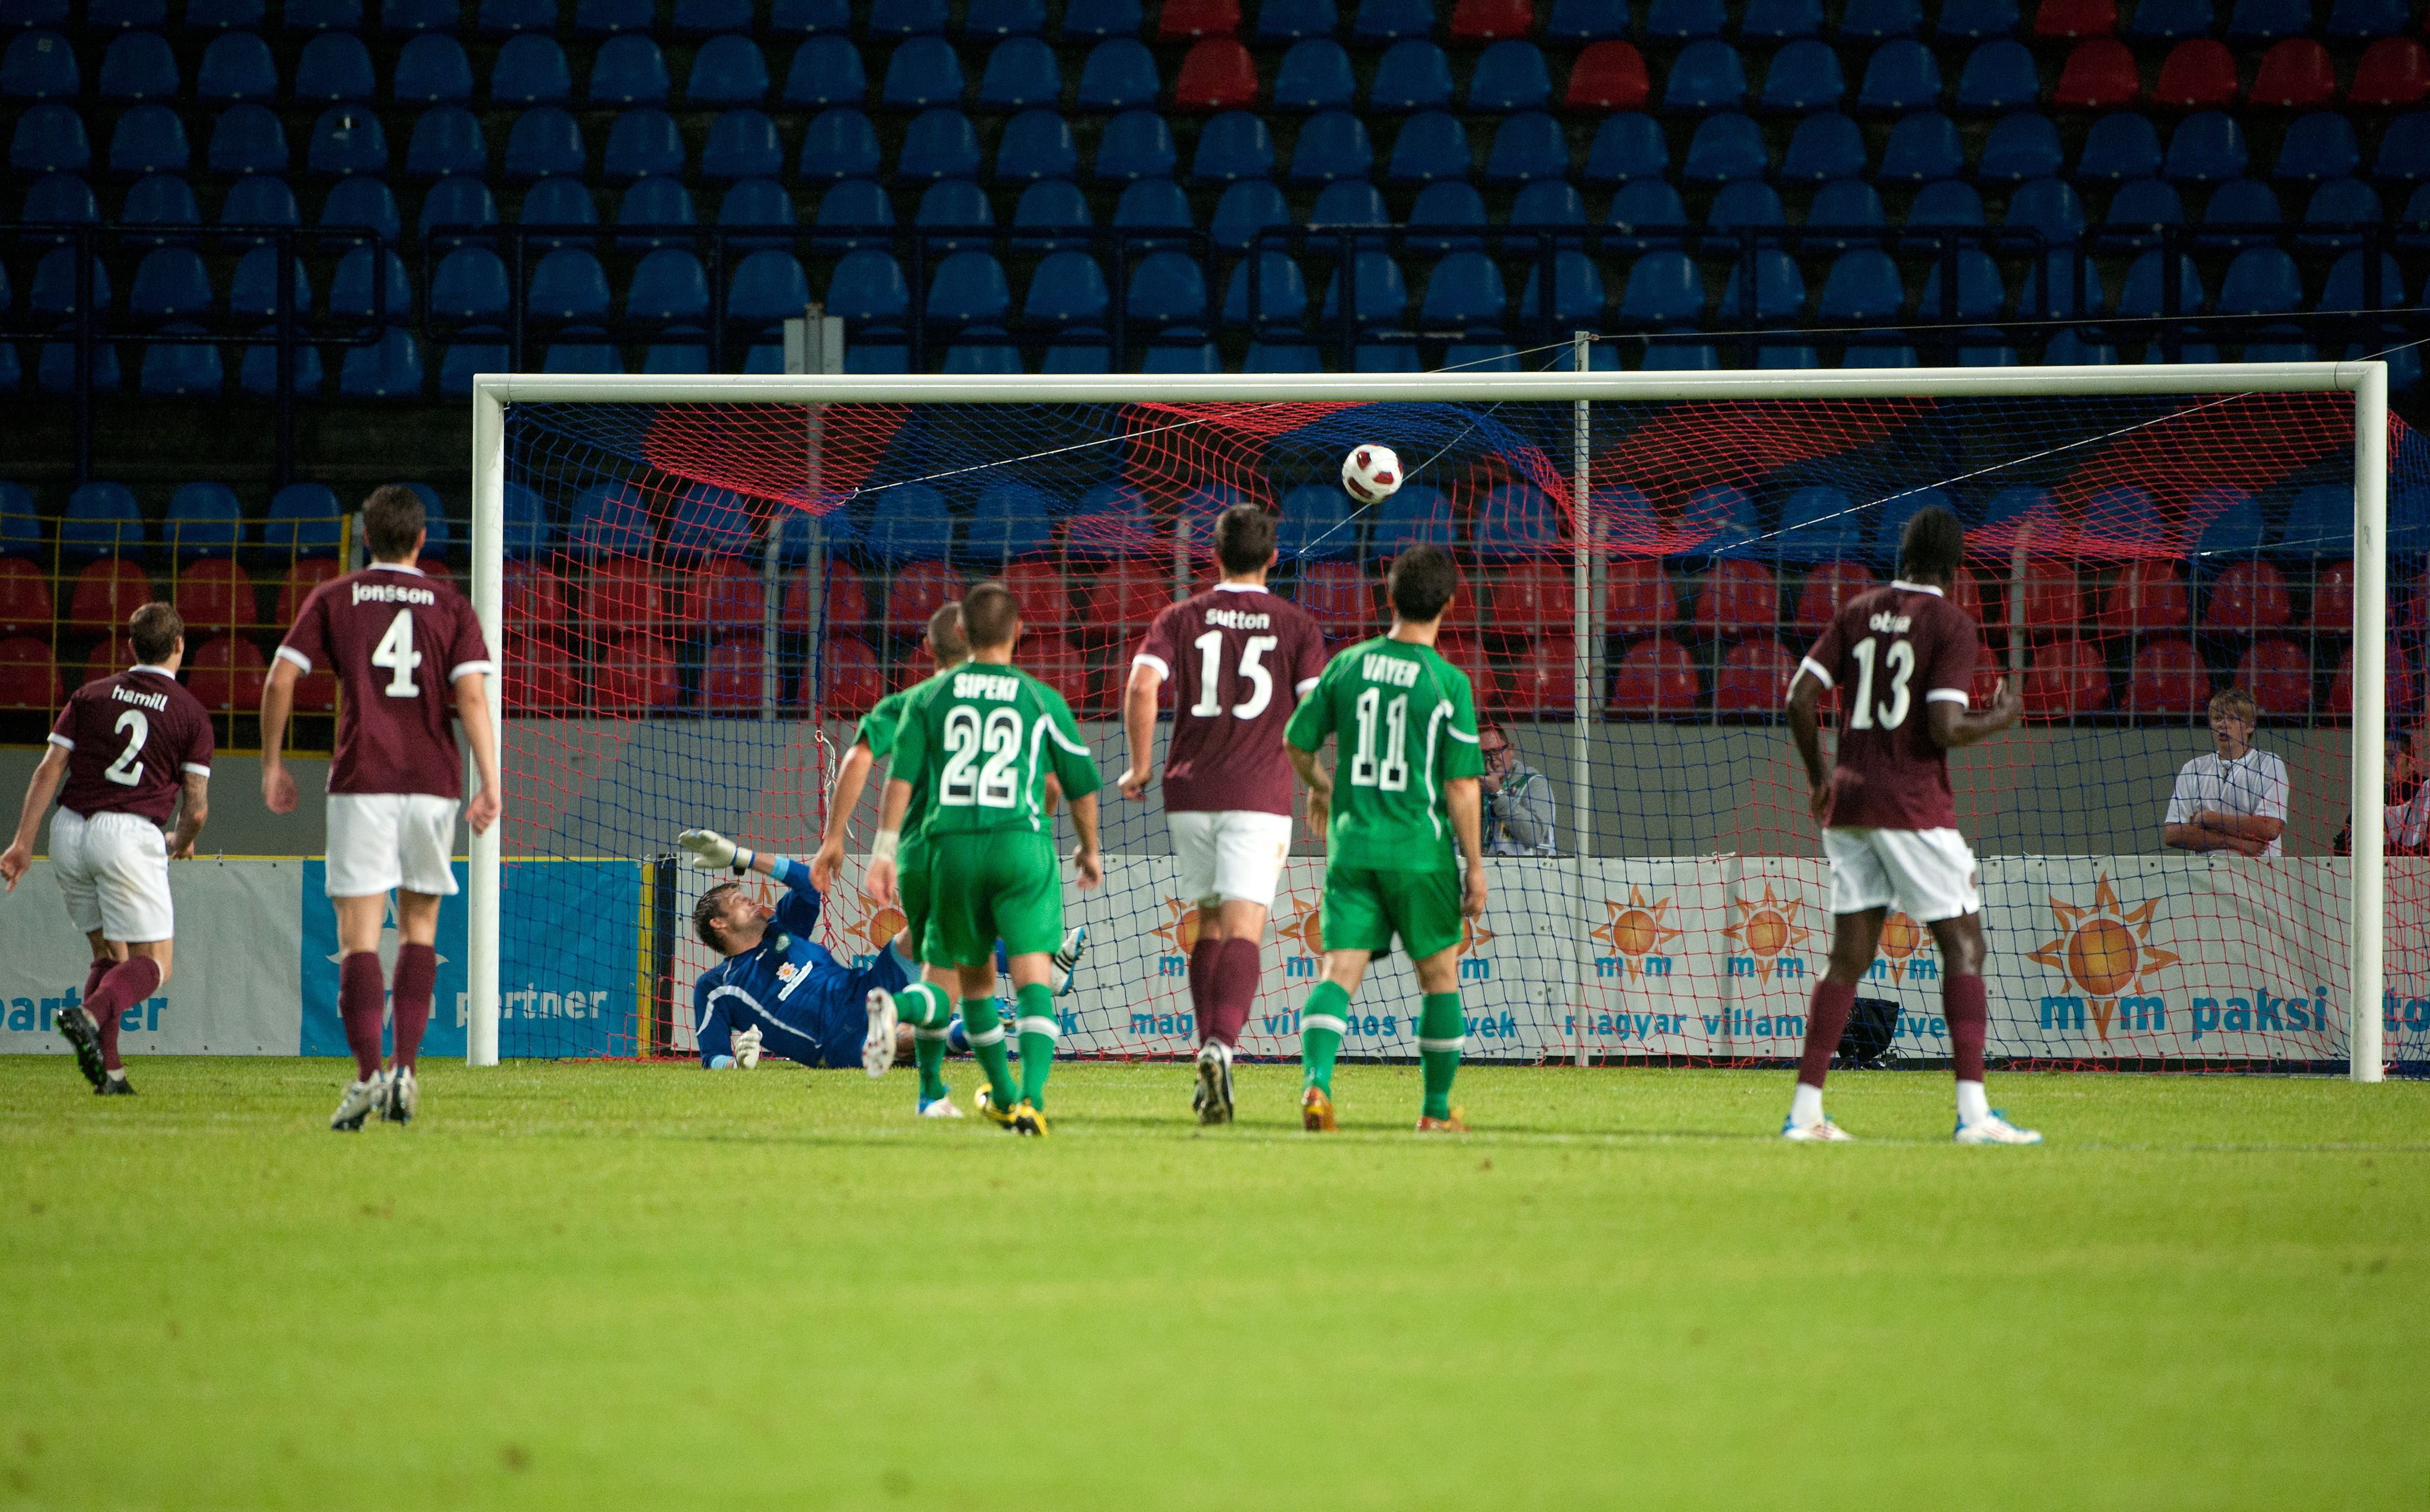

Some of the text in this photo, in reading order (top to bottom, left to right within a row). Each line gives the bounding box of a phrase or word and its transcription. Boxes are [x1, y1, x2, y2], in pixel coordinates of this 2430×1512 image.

[352, 581, 435, 606] jonsson
[1205, 608, 1271, 630] sutton
[372, 608, 422, 698] 4
[1191, 629, 1278, 720] 15
[1362, 653, 1421, 688] VAYER
[111, 684, 168, 712] hamill
[953, 673, 1019, 702] SIPEKI
[1851, 637, 1915, 731] 13
[104, 709, 149, 787] 2
[939, 704, 1023, 808] 22
[1351, 686, 1408, 792] 11
[0, 986, 168, 1031] arter
[456, 983, 608, 1028] prtner
[1700, 1007, 1802, 1037] villam
[2192, 987, 2327, 1041] paksi
